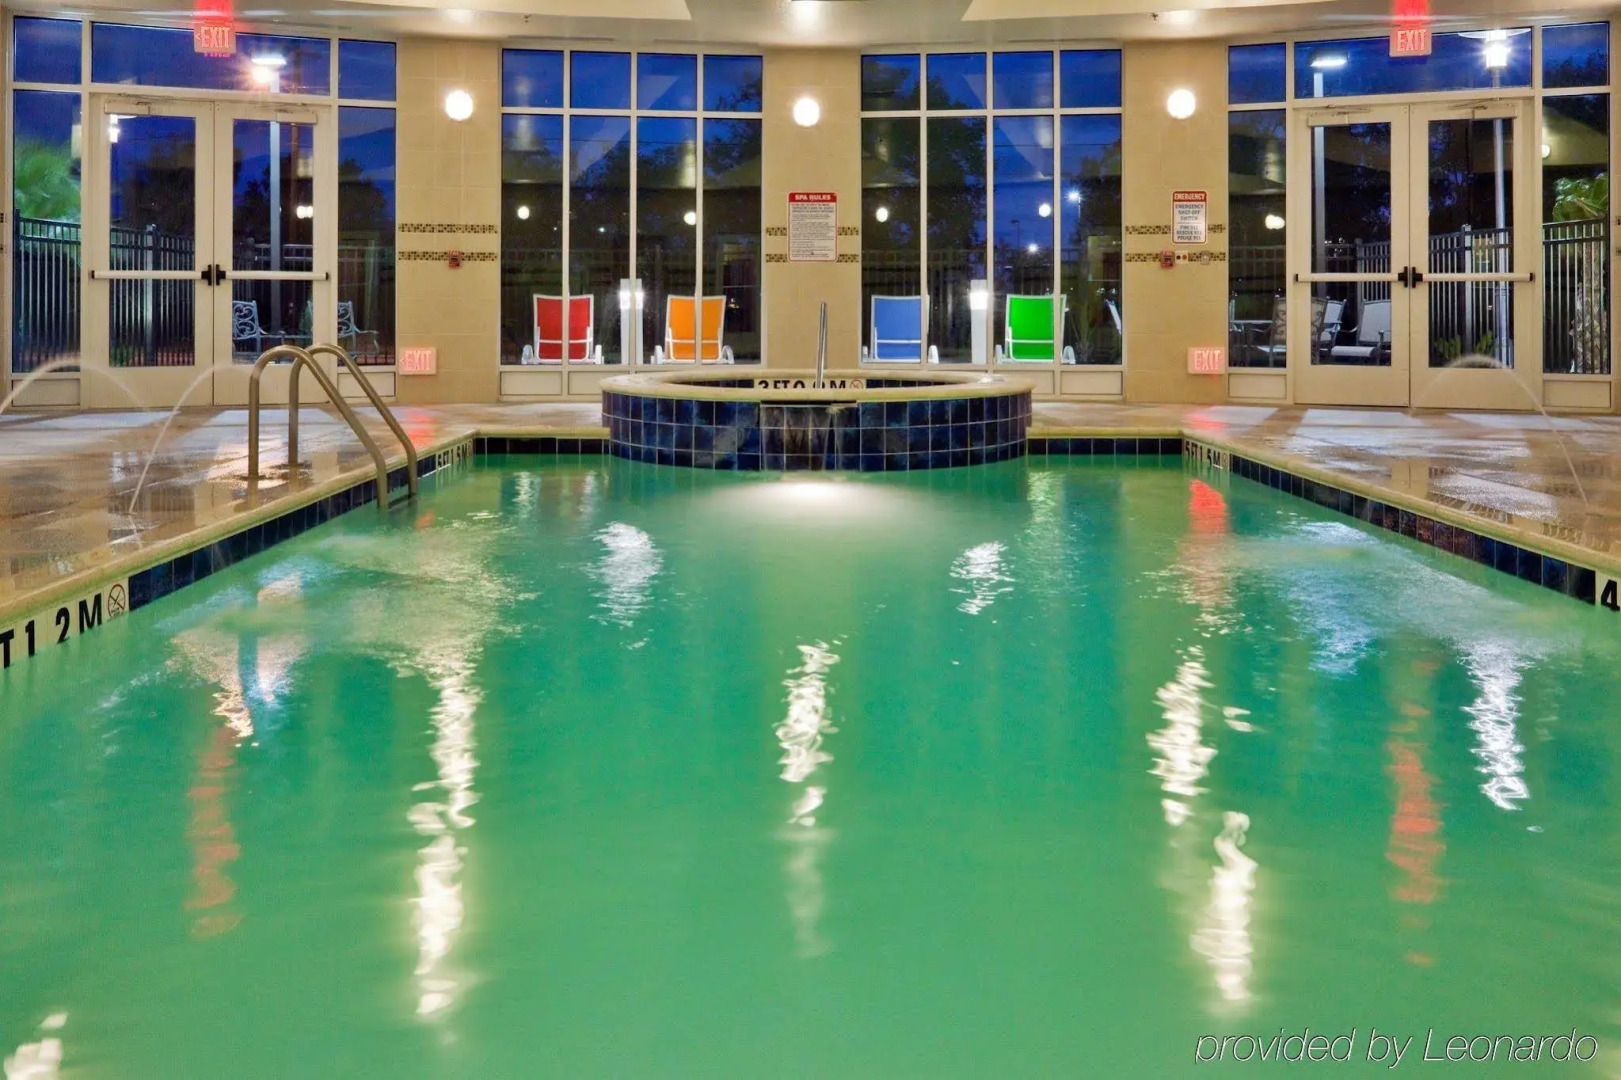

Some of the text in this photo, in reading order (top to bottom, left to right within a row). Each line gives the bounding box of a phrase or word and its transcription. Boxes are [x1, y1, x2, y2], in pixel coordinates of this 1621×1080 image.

[201, 26, 230, 48] EXIT
[1396, 30, 1427, 51] EXIT
[404, 350, 431, 370] EXIT
[1195, 350, 1221, 370] EXIT
[1600, 579, 1621, 612] 4
